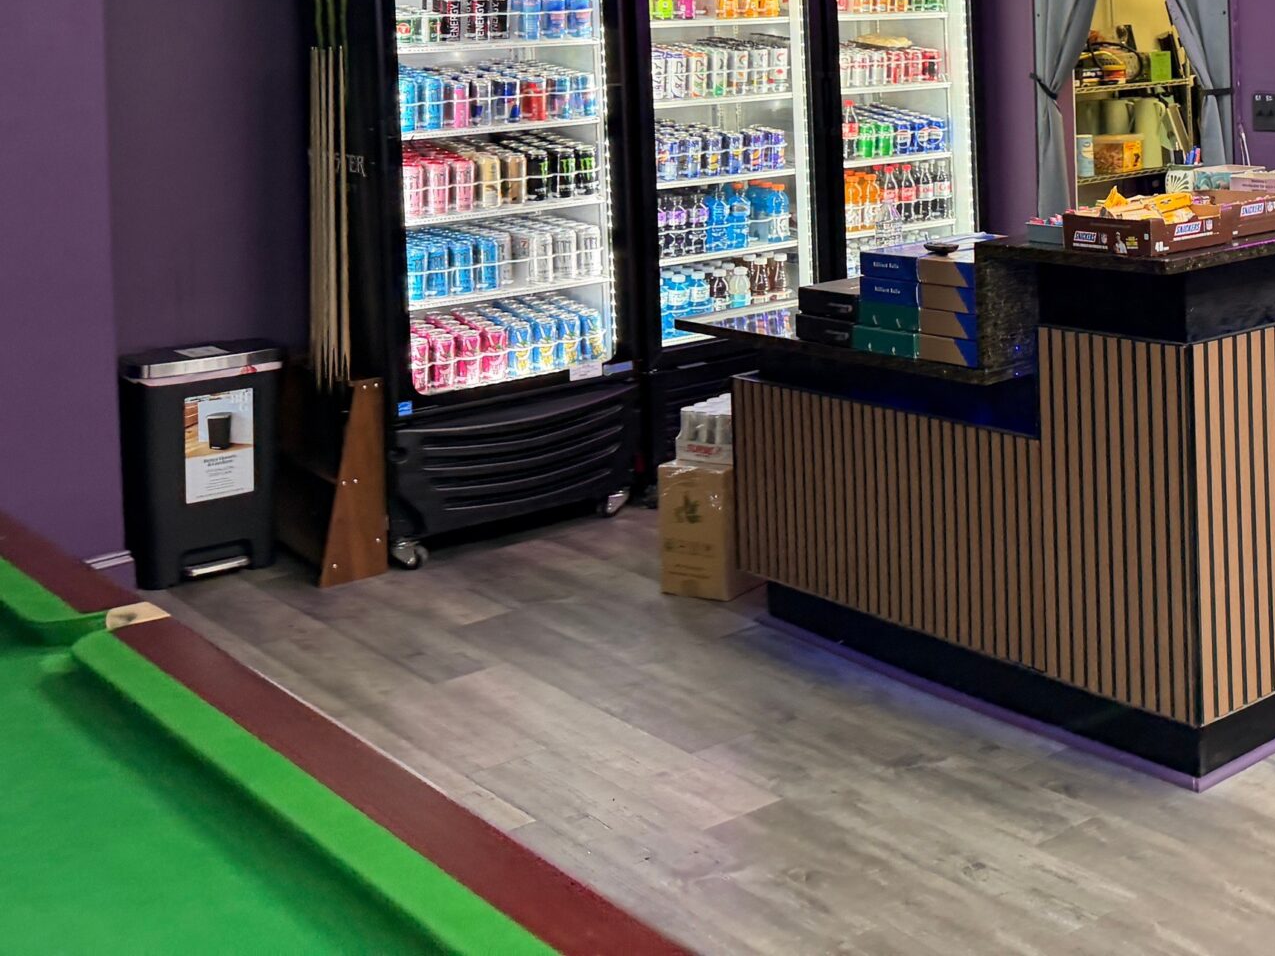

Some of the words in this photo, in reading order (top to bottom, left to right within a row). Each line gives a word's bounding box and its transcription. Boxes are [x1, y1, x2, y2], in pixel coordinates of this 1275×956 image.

[450, 3, 459, 38] ENERGY
[1242, 204, 1262, 215] SNICKERS
[1176, 224, 1200, 234] SNICKERS
[1075, 232, 1096, 242] SNICKERS
